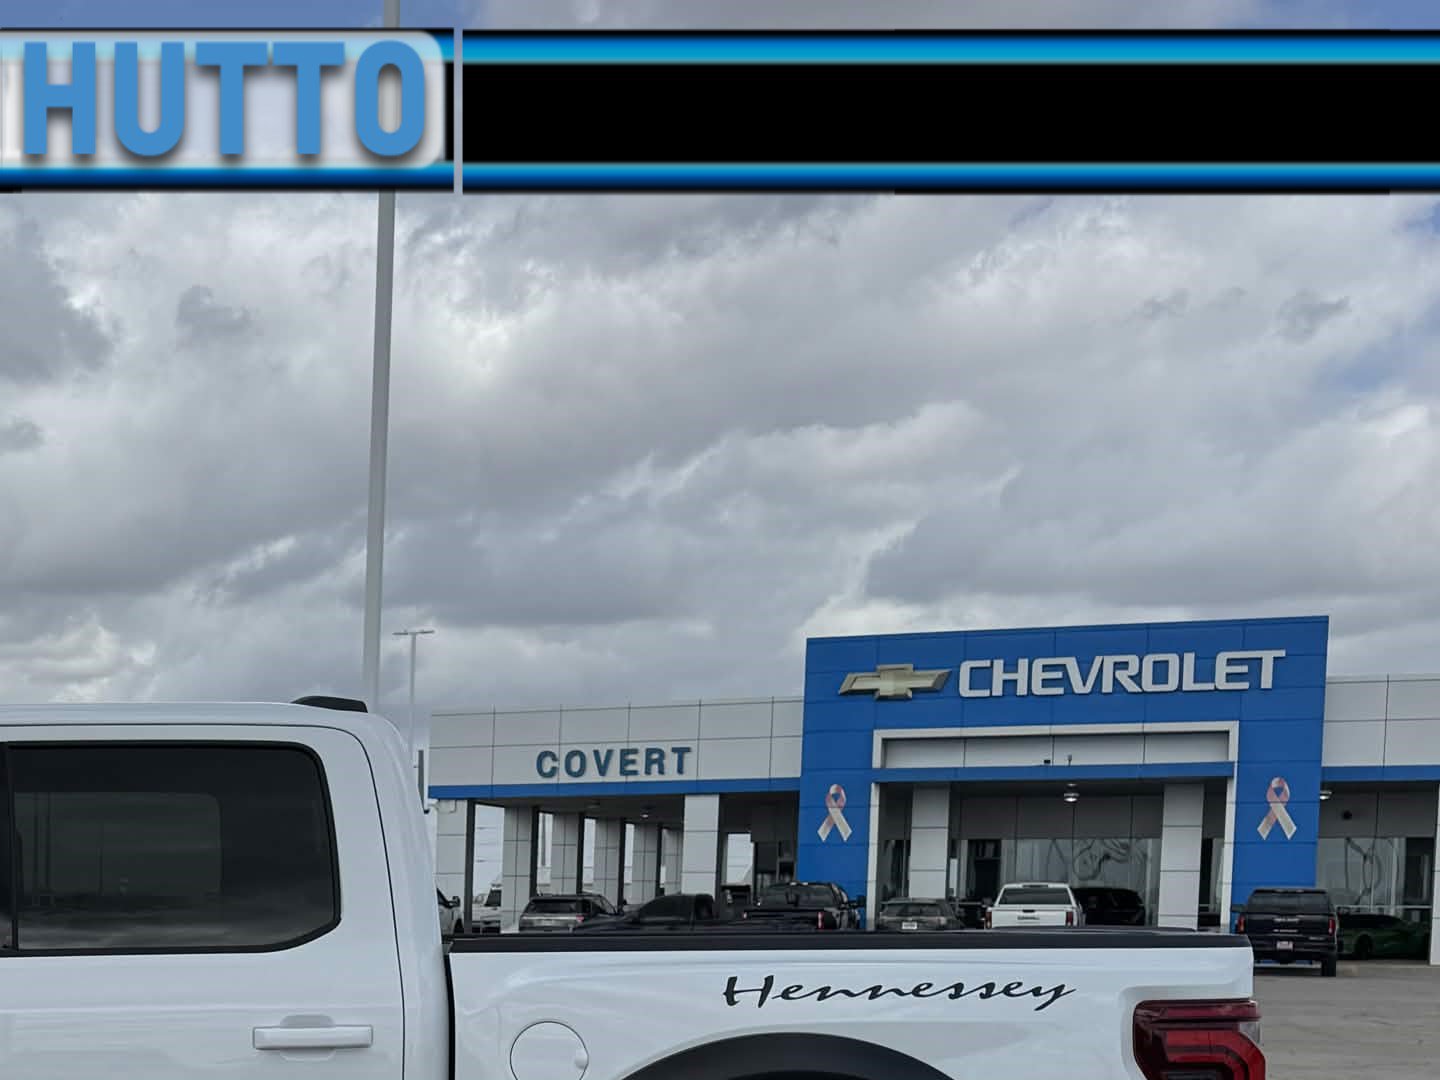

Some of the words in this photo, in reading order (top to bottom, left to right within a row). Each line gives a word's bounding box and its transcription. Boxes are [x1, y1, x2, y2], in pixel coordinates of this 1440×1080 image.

[959, 649, 1287, 698] CHEVROLET
[536, 746, 692, 778] COVERT
[723, 974, 1076, 1011] Hennessey
